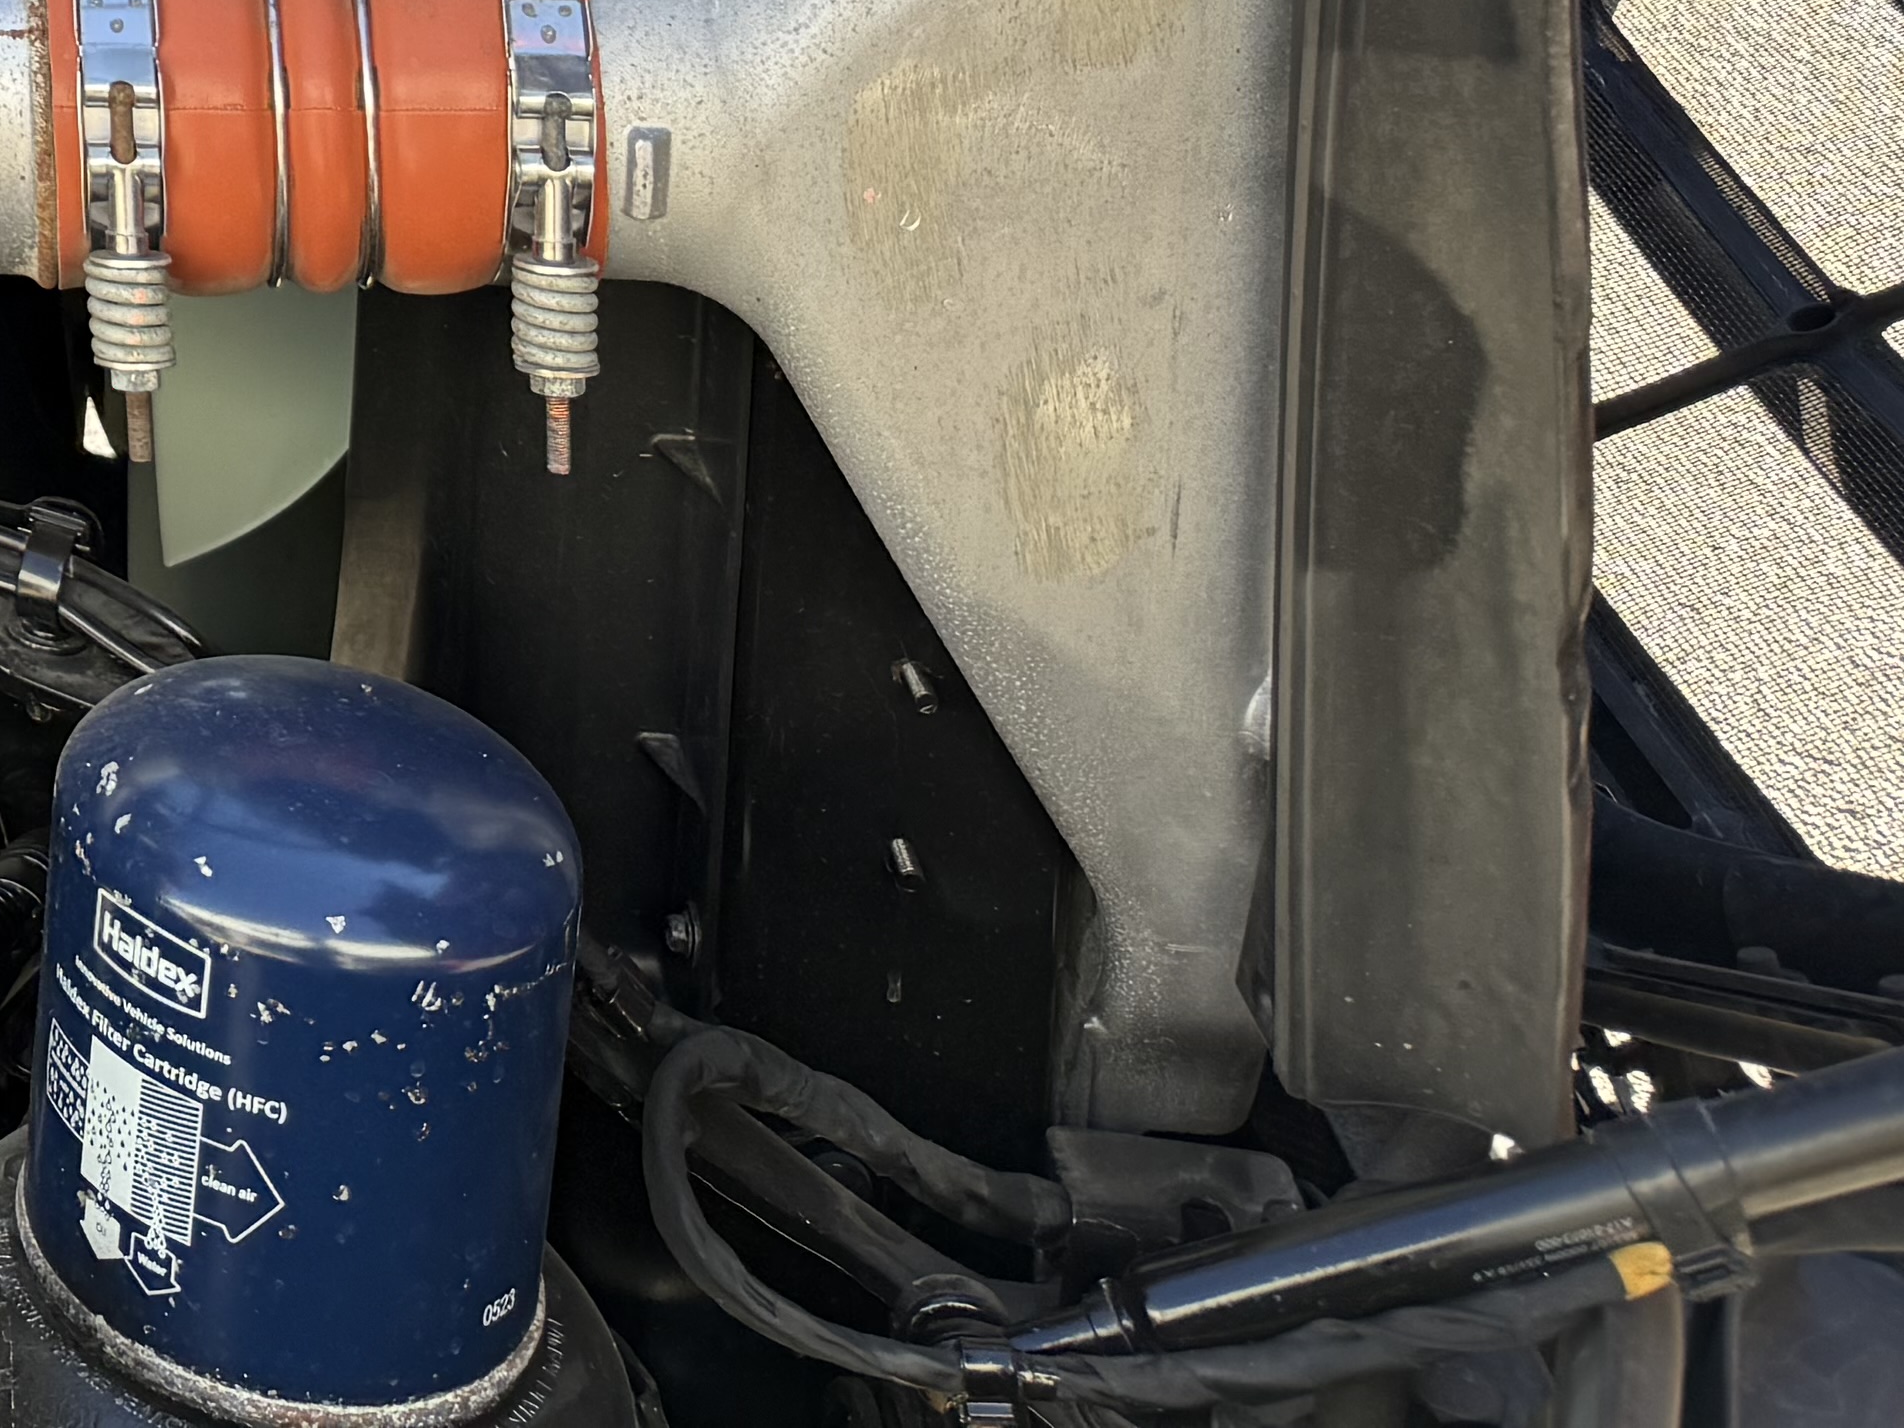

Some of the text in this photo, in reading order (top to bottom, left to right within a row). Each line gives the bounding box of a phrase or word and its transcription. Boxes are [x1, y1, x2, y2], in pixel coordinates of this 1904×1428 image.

[102, 910, 201, 1000] Haldex
[122, 997, 165, 1036] Vehicle
[166, 1026, 232, 1066] Solutions
[92, 1008, 130, 1052] Filter
[133, 1043, 223, 1101] Cartridge
[227, 1087, 288, 1124] (HFC)
[201, 1172, 258, 1203] clean air
[137, 1251, 168, 1277] Water
[482, 1287, 516, 1327] 0523
